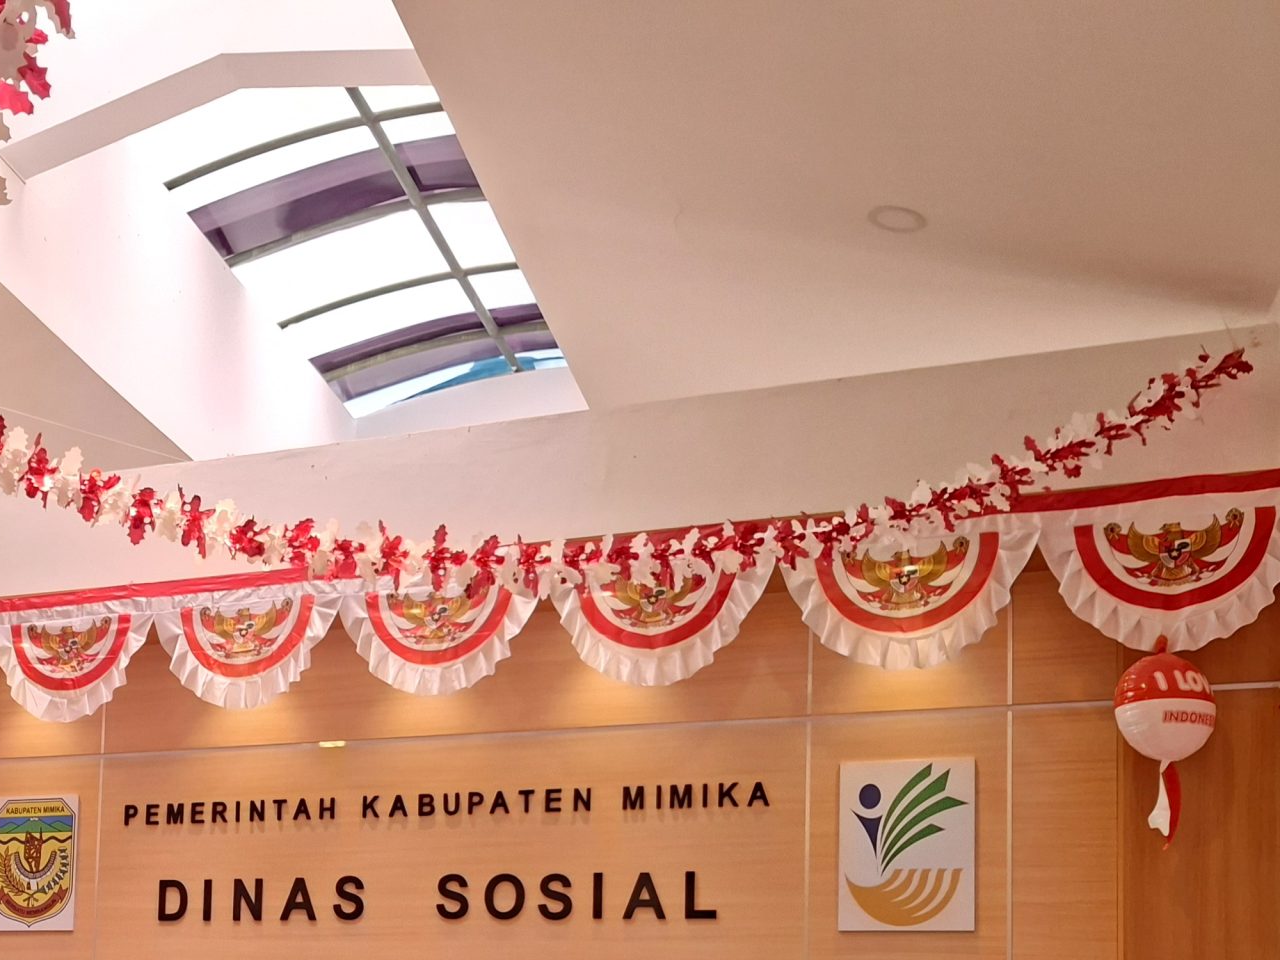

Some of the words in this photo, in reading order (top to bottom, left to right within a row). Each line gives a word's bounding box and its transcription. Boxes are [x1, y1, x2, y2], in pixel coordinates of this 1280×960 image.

[6, 807, 42, 815] KABUPATEN
[124, 797, 337, 826] PEMERINTAH
[361, 788, 593, 818] KABUPATEN
[621, 782, 771, 811] MIMIKA
[158, 876, 366, 922] DINAS
[435, 870, 718, 921] SOSIAL
